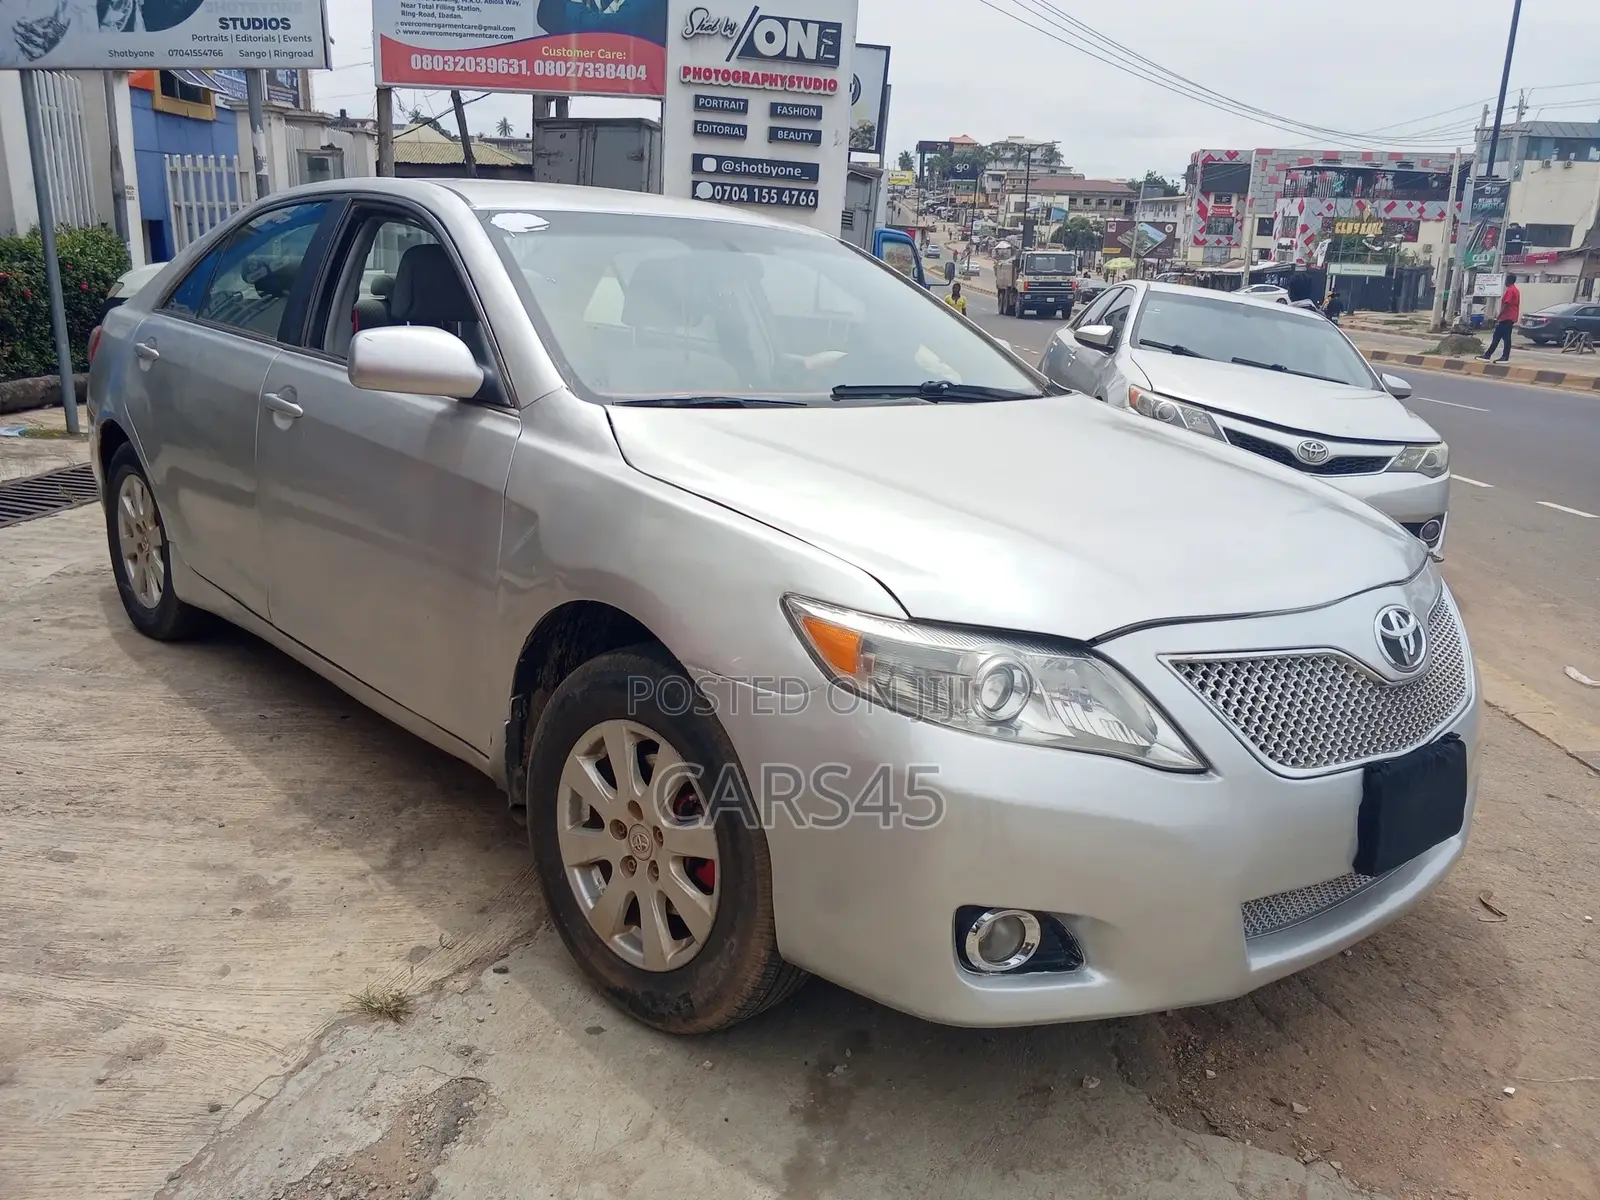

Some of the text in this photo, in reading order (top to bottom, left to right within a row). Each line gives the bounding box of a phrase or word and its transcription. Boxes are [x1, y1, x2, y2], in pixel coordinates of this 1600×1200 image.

[401, 10, 437, 19] Ring-Road,
[436, 4, 456, 12] Filling
[457, 5, 482, 13] Station,
[218, 16, 292, 31] STUDIOS
[400, 20, 516, 32] overcomersgarmentcare@gmail.com
[191, 34, 313, 43] Portraits Editorials Events
[403, 28, 514, 40] www.overcomersgarmentcare.com
[108, 49, 314, 59] Shotbyone 07041554766 Sango Ringroad
[541, 46, 627, 60] Customer Care:
[410, 53, 648, 81] 08032039631, 08027338404
[698, 97, 745, 111] PORTRAIT
[777, 105, 817, 117] FASHION
[696, 123, 745, 136] EDITORIAL
[777, 130, 813, 141] BEAUTY
[721, 160, 810, 180] @shotbyone_
[714, 185, 816, 206] 0704 155 4766
